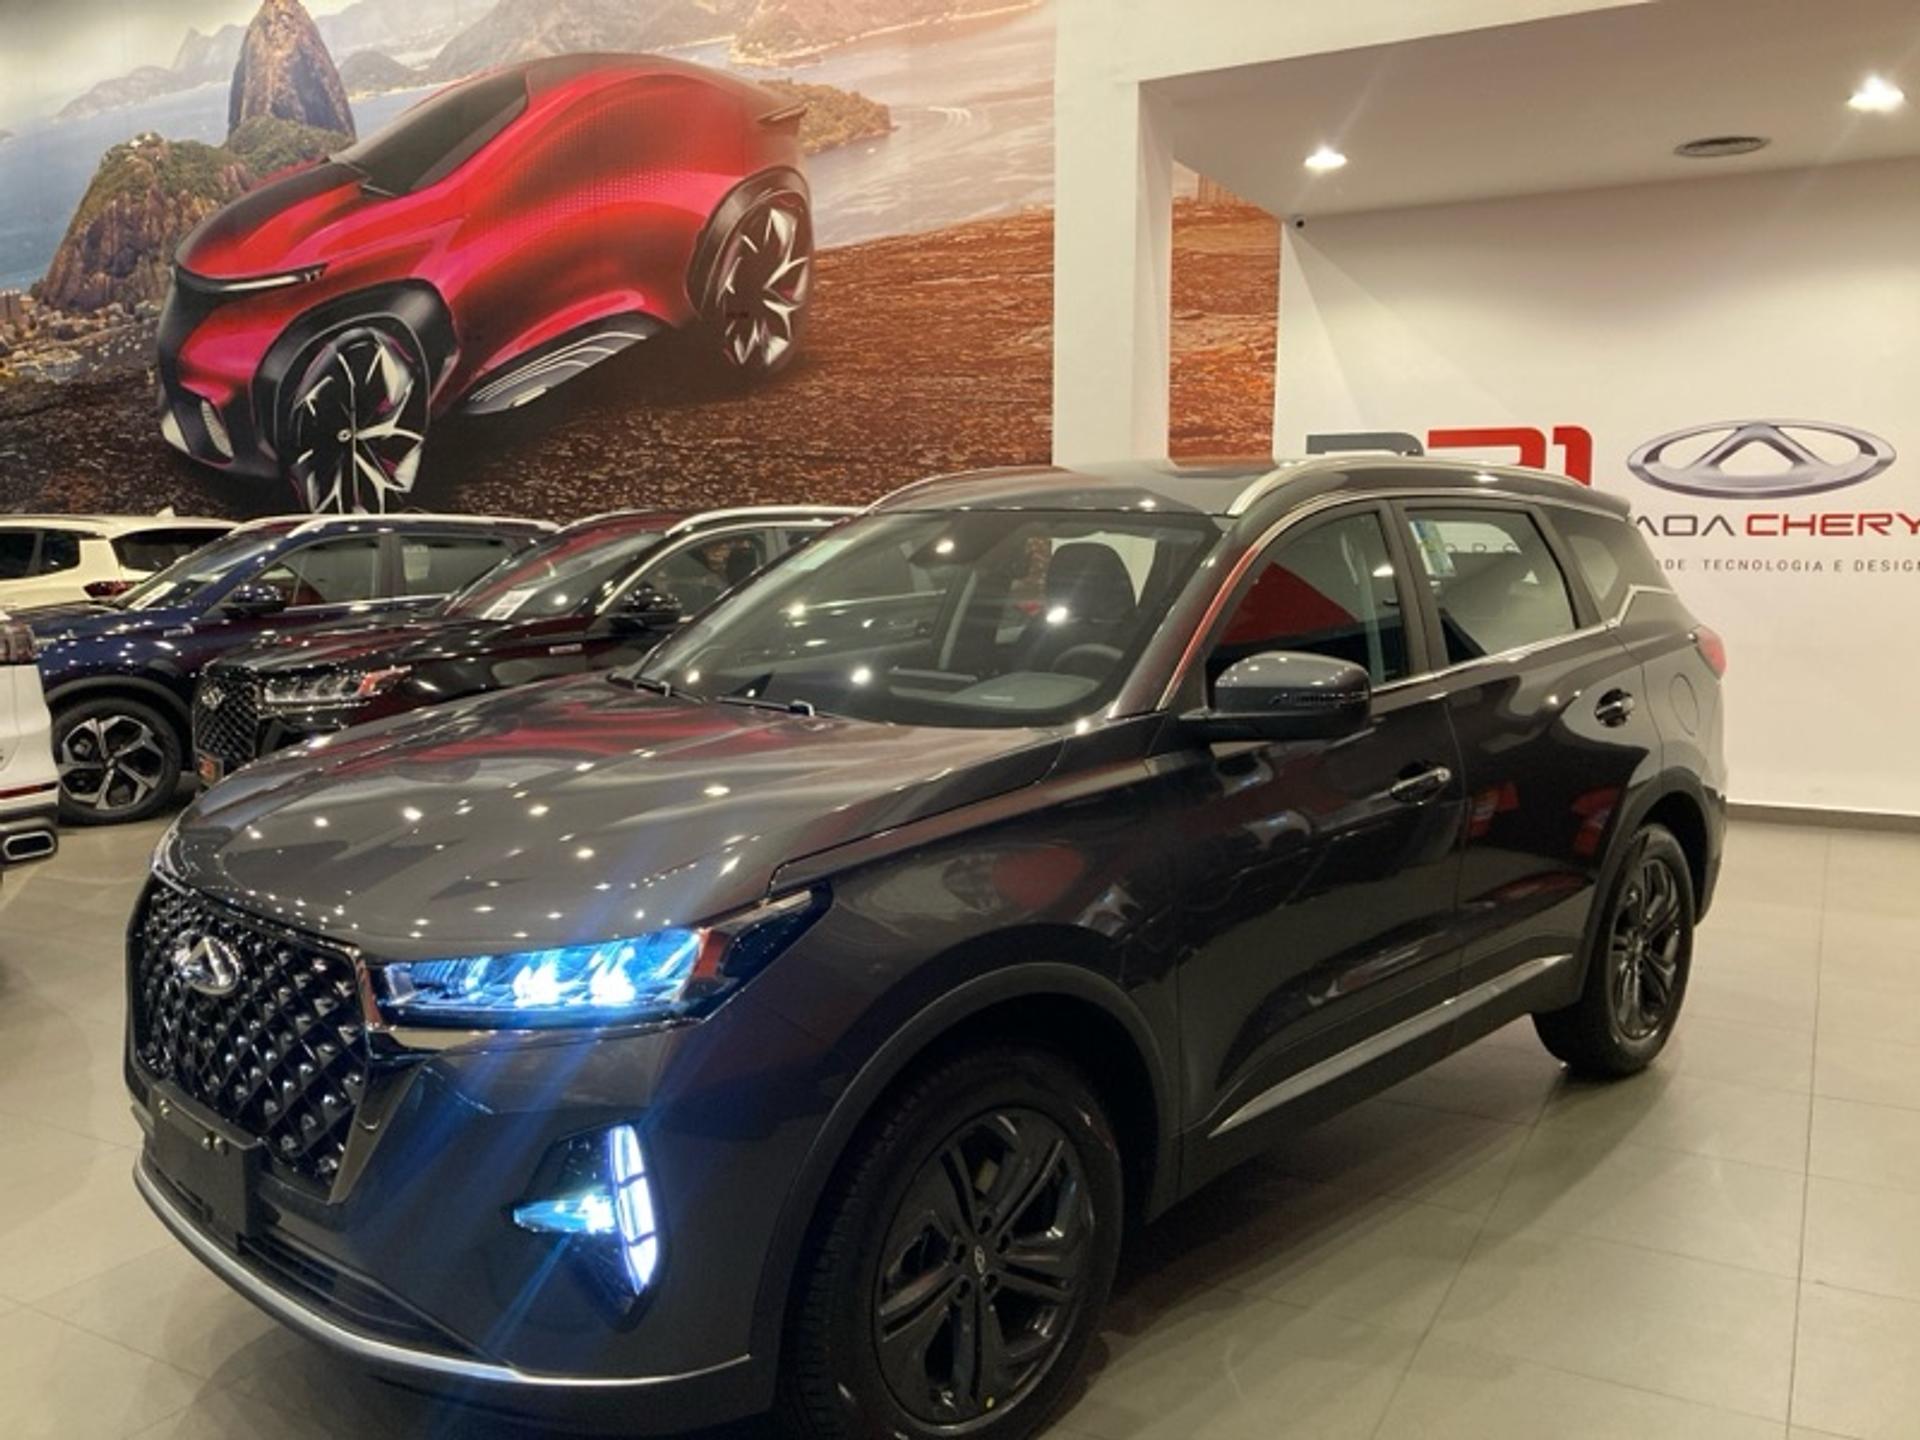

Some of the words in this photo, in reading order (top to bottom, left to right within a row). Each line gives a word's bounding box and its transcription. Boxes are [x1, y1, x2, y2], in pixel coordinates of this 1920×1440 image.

[1636, 514, 1735, 536] AOA
[1746, 513, 1920, 536] CHERY
[1656, 559, 1686, 571] DE
[1703, 559, 1823, 572] TECNOLOGIA
[1833, 559, 1843, 572] E
